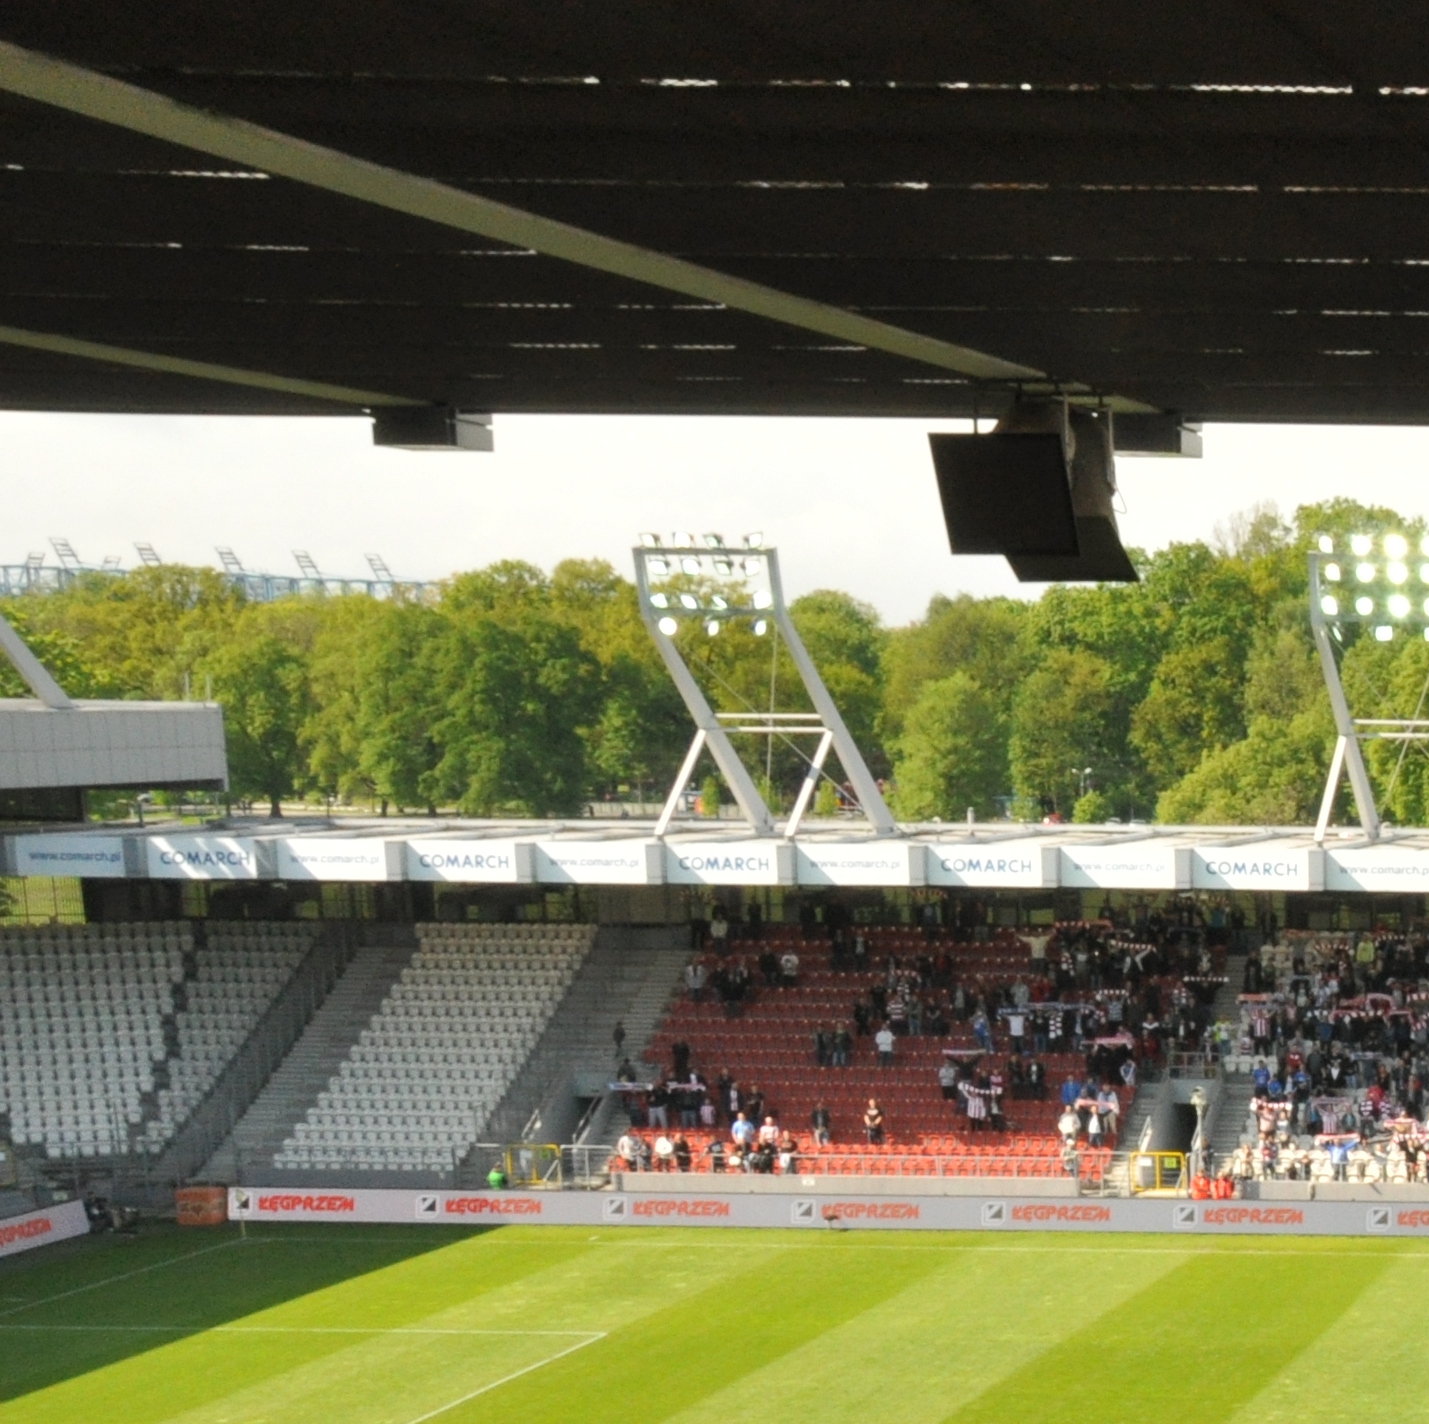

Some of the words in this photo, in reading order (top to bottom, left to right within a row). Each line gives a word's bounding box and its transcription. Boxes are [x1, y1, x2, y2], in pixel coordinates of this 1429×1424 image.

[160, 850, 250, 866] COMARCH
[420, 853, 509, 870] COMARCH
[679, 856, 769, 872] COMARCH
[941, 858, 1032, 874] COMARCH
[1206, 861, 1298, 877] COMARCH
